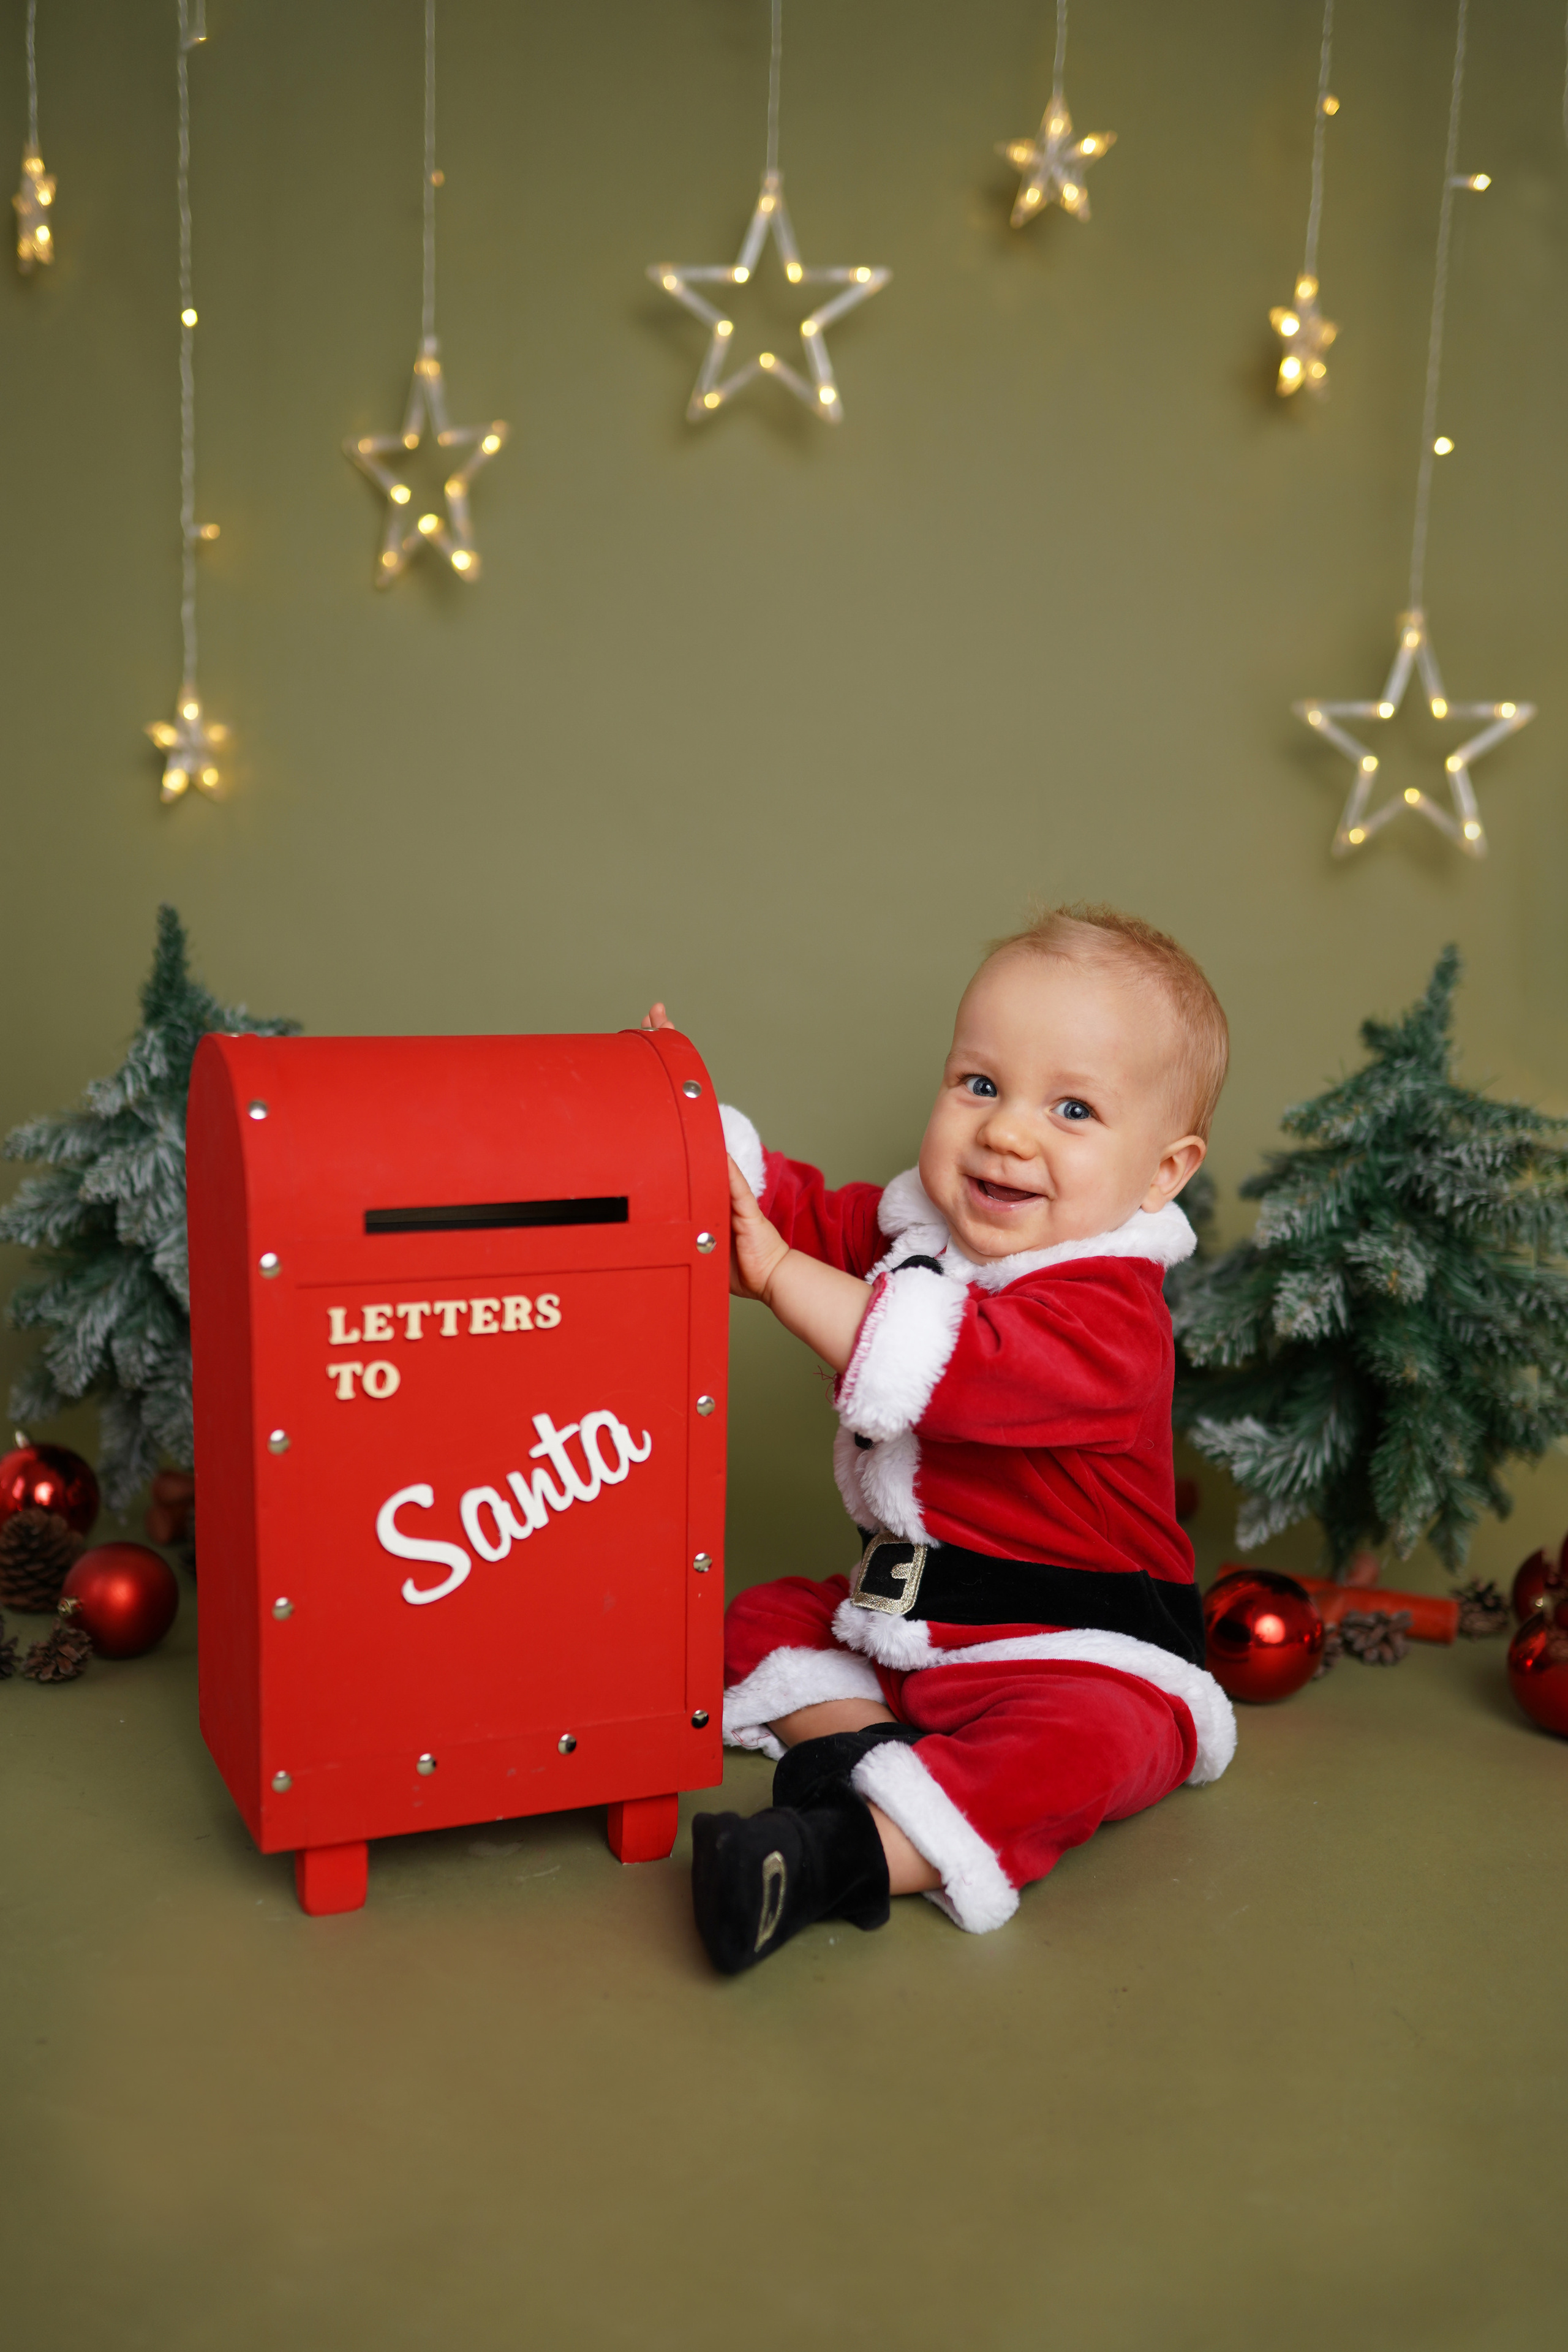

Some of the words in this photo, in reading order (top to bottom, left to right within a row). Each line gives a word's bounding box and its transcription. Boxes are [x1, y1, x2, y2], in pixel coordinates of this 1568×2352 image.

[327, 1294, 562, 1344] LETTERS
[326, 1360, 401, 1400] TO
[375, 1409, 652, 1605] Santa
